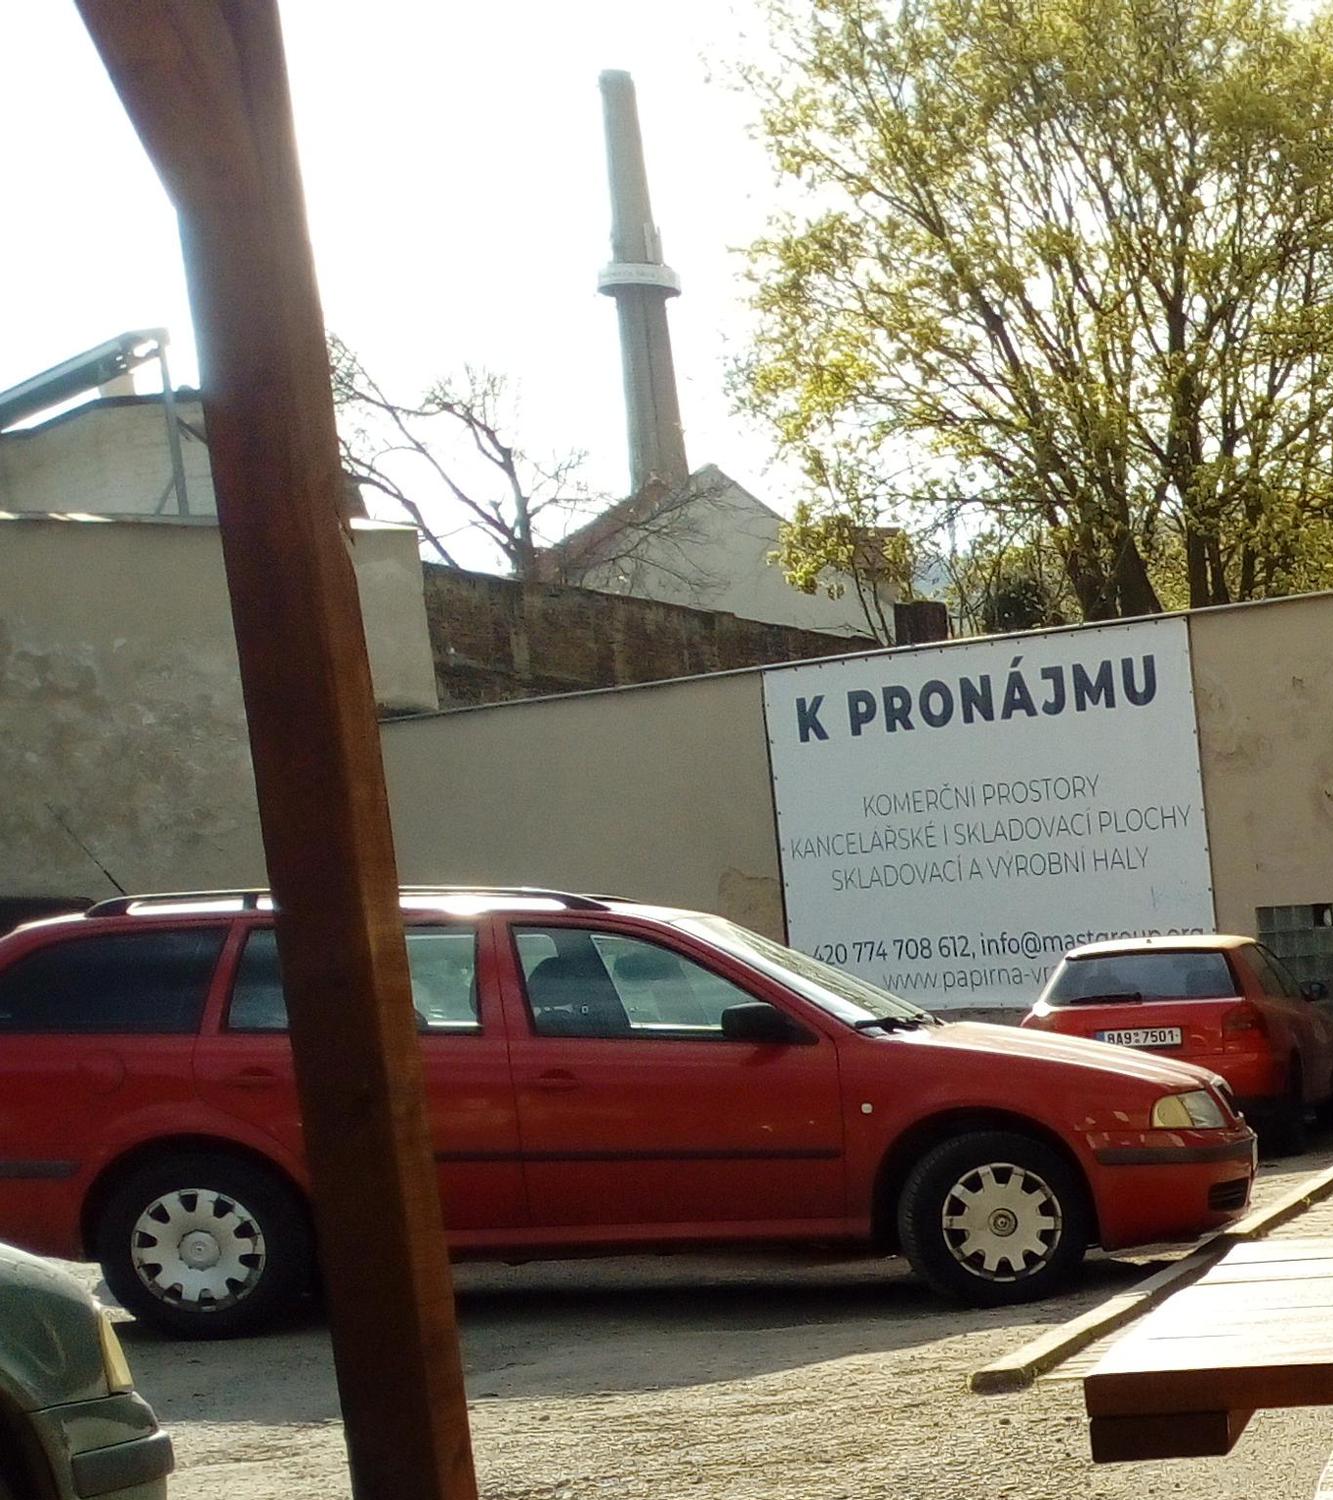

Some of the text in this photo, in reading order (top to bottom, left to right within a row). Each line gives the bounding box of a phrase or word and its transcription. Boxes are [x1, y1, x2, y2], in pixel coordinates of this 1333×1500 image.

[795, 654, 1157, 743] K PRONÁJMU
[863, 774, 1099, 817] KOMERČNÍ PROSTORY
[791, 804, 1191, 860] KANCELÁŘSKÉ I SKLADOVACÍ PLOCHY
[831, 847, 1149, 891] SKLADOVACÍ A VÝROBNÍ HALY
[852, 941, 888, 963] 774
[893, 937, 933, 960] 708
[938, 935, 976, 959] 612,
